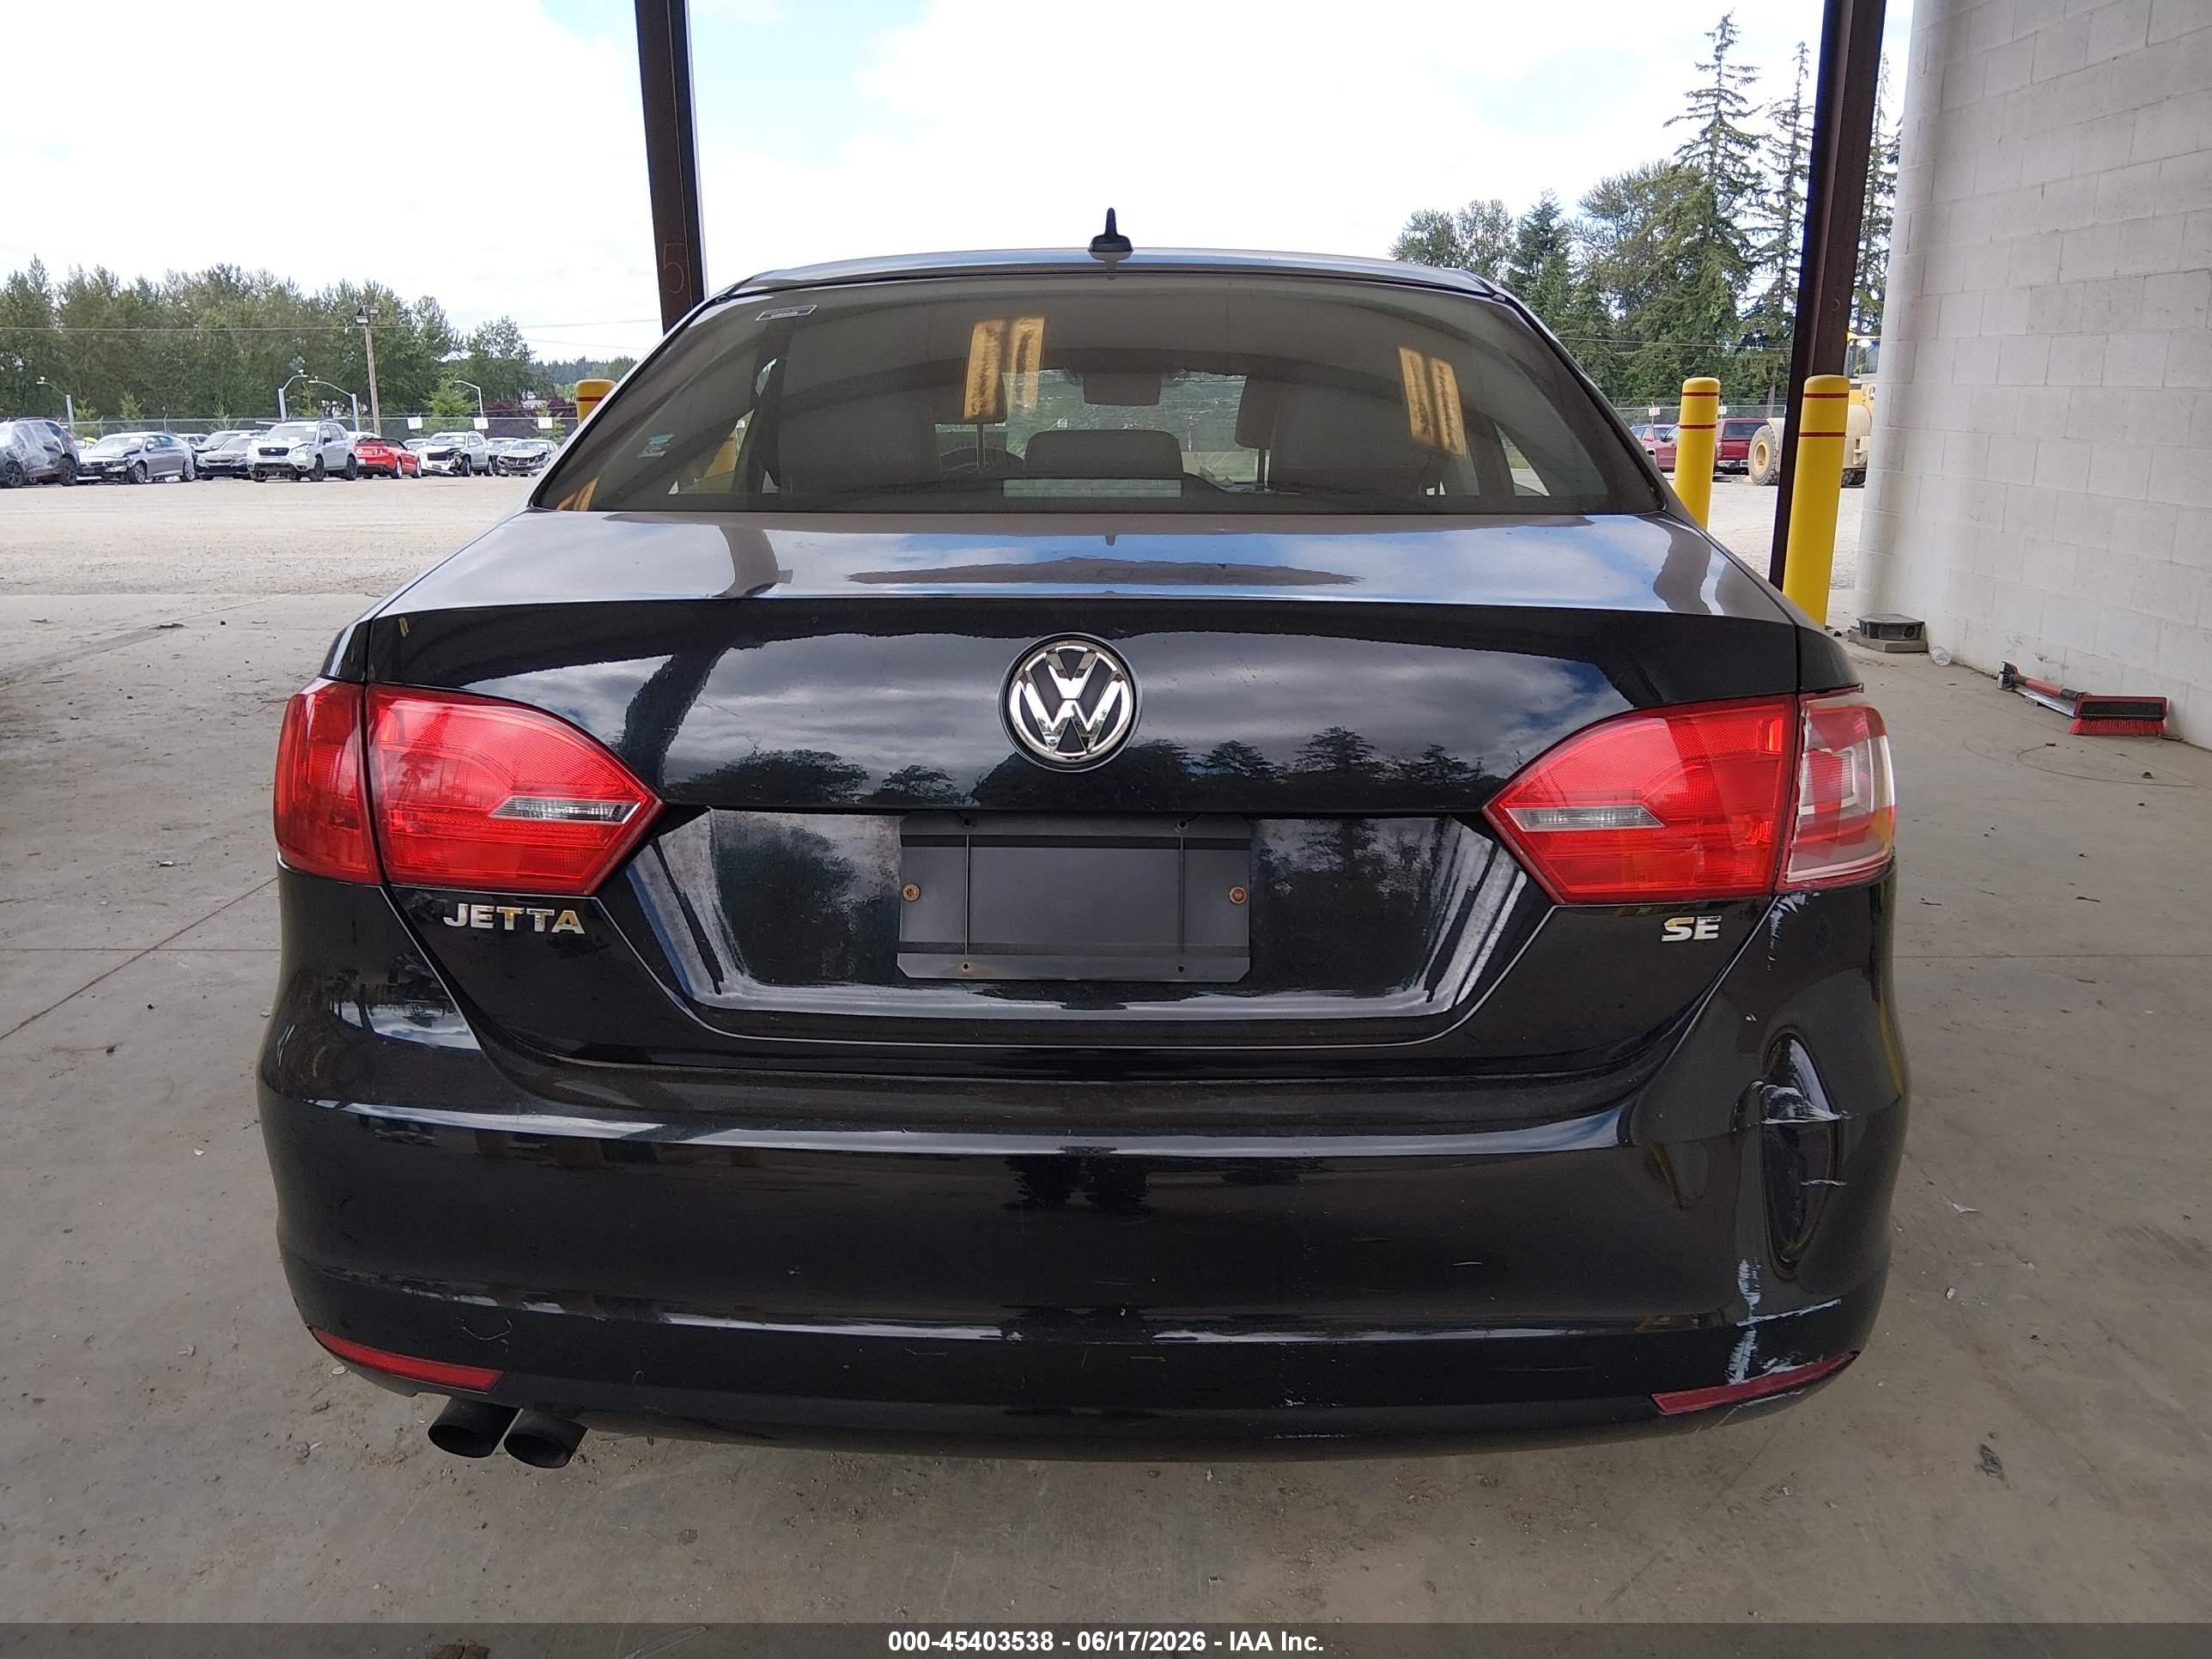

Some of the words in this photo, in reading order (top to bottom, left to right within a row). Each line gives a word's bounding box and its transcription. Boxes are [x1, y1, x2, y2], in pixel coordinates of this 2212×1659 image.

[1009, 641, 1133, 761] VW
[443, 903, 586, 934] JETTA
[1661, 915, 1722, 942] SE
